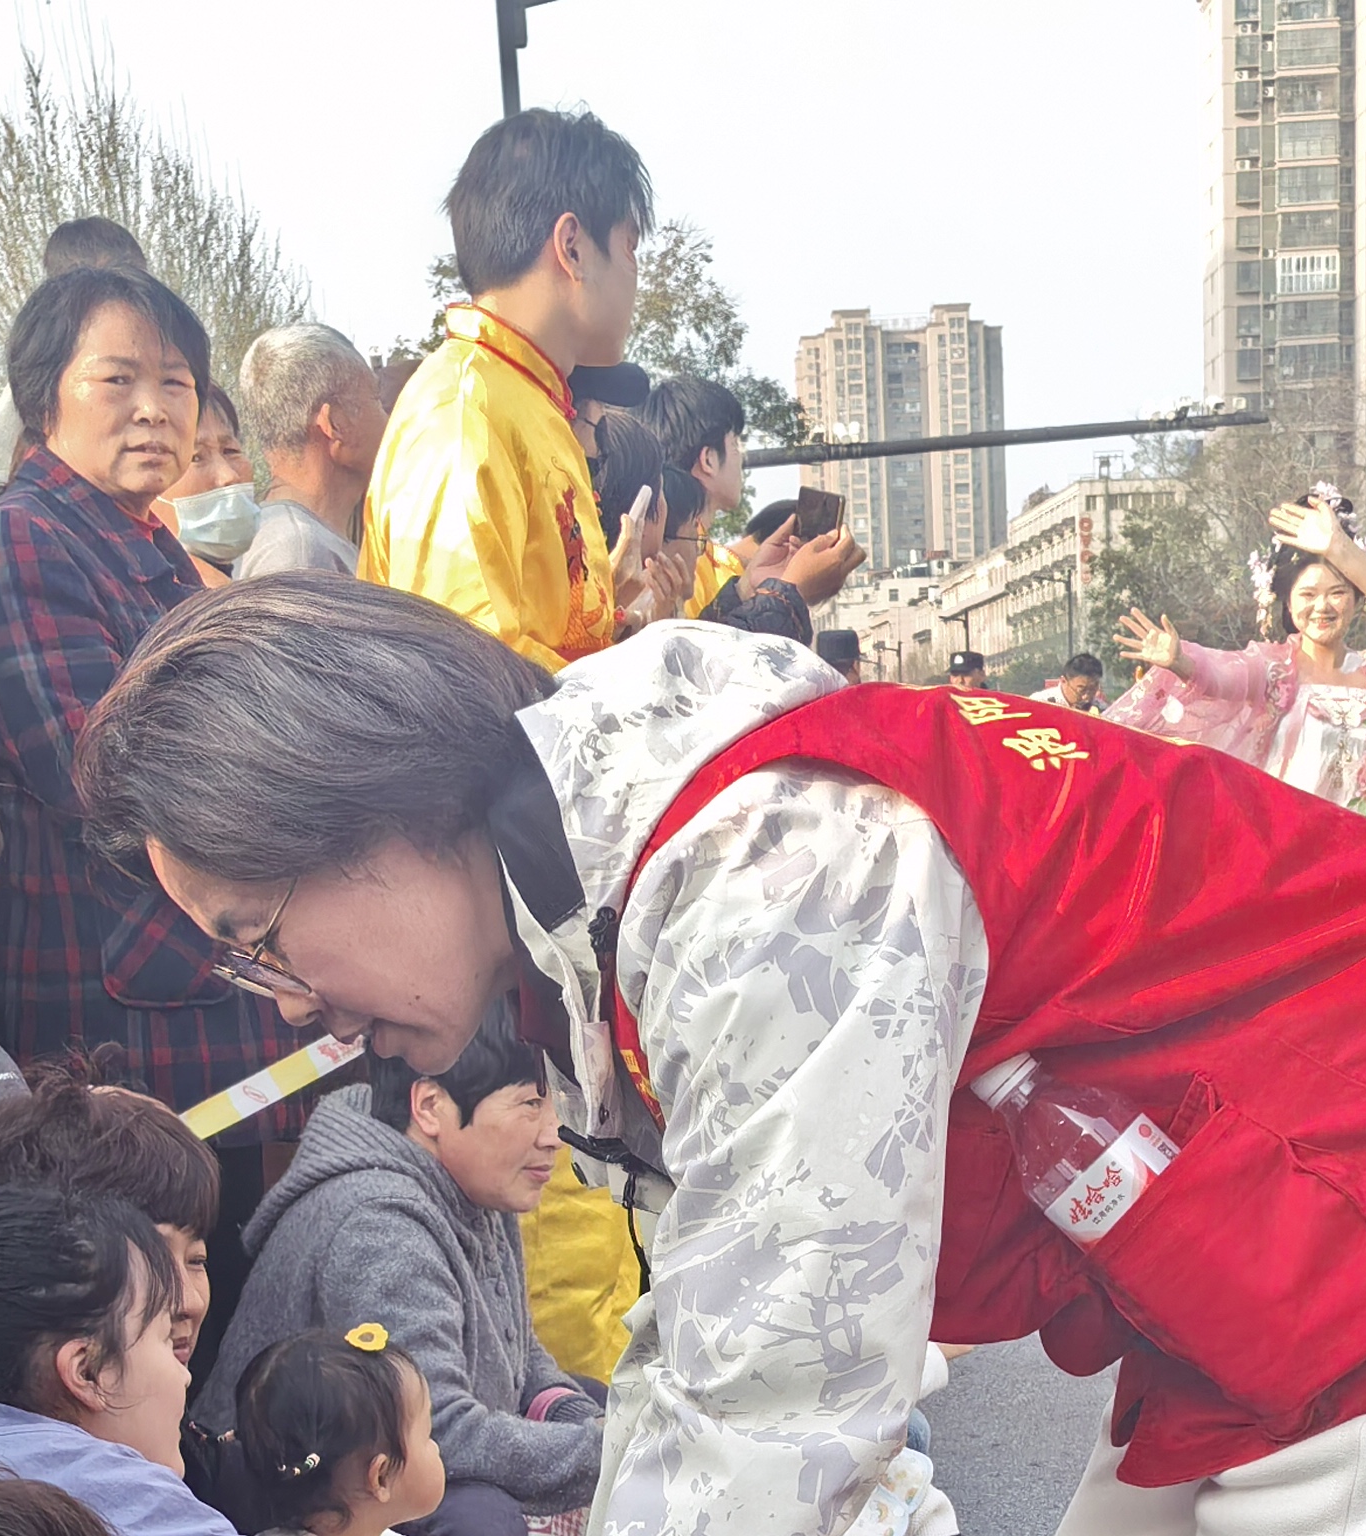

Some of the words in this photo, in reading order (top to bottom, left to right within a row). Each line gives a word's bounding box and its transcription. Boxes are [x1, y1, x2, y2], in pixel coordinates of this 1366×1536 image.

[1069, 1166, 1123, 1225] 娃哈哈
[1092, 1194, 1125, 1225] 饮用纯净水
